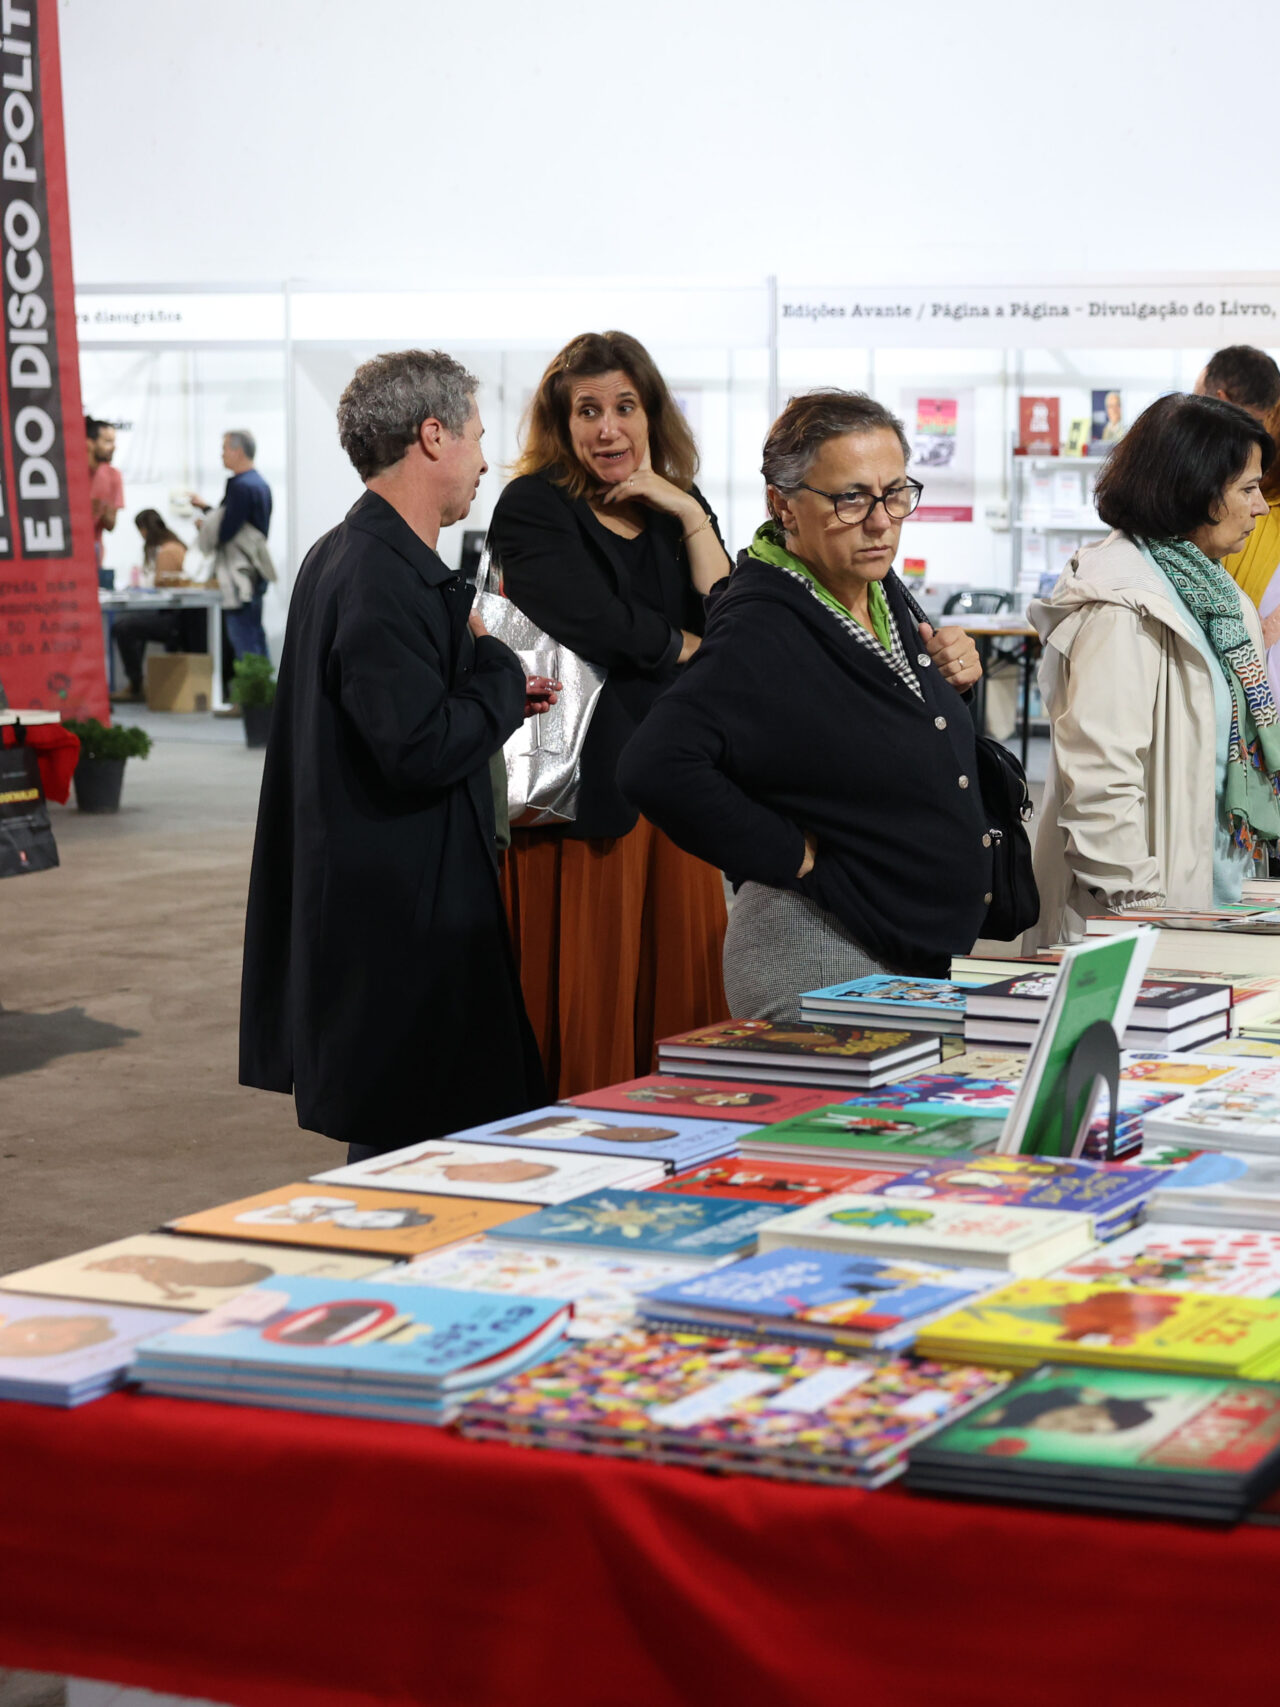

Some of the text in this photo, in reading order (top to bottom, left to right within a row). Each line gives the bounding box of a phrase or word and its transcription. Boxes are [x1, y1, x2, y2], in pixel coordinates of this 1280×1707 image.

[4, 199, 52, 389] DISCO
[782, 302, 847, 322] Edições
[851, 303, 913, 319] Avante
[931, 302, 991, 321] Página
[994, 306, 1006, 318] a
[1010, 302, 1070, 321] Página
[1087, 301, 1189, 321] Divulgação
[1193, 301, 1216, 317] do
[1220, 300, 1277, 319] Livro,
[15, 405, 60, 500] DO
[24, 516, 65, 552] E
